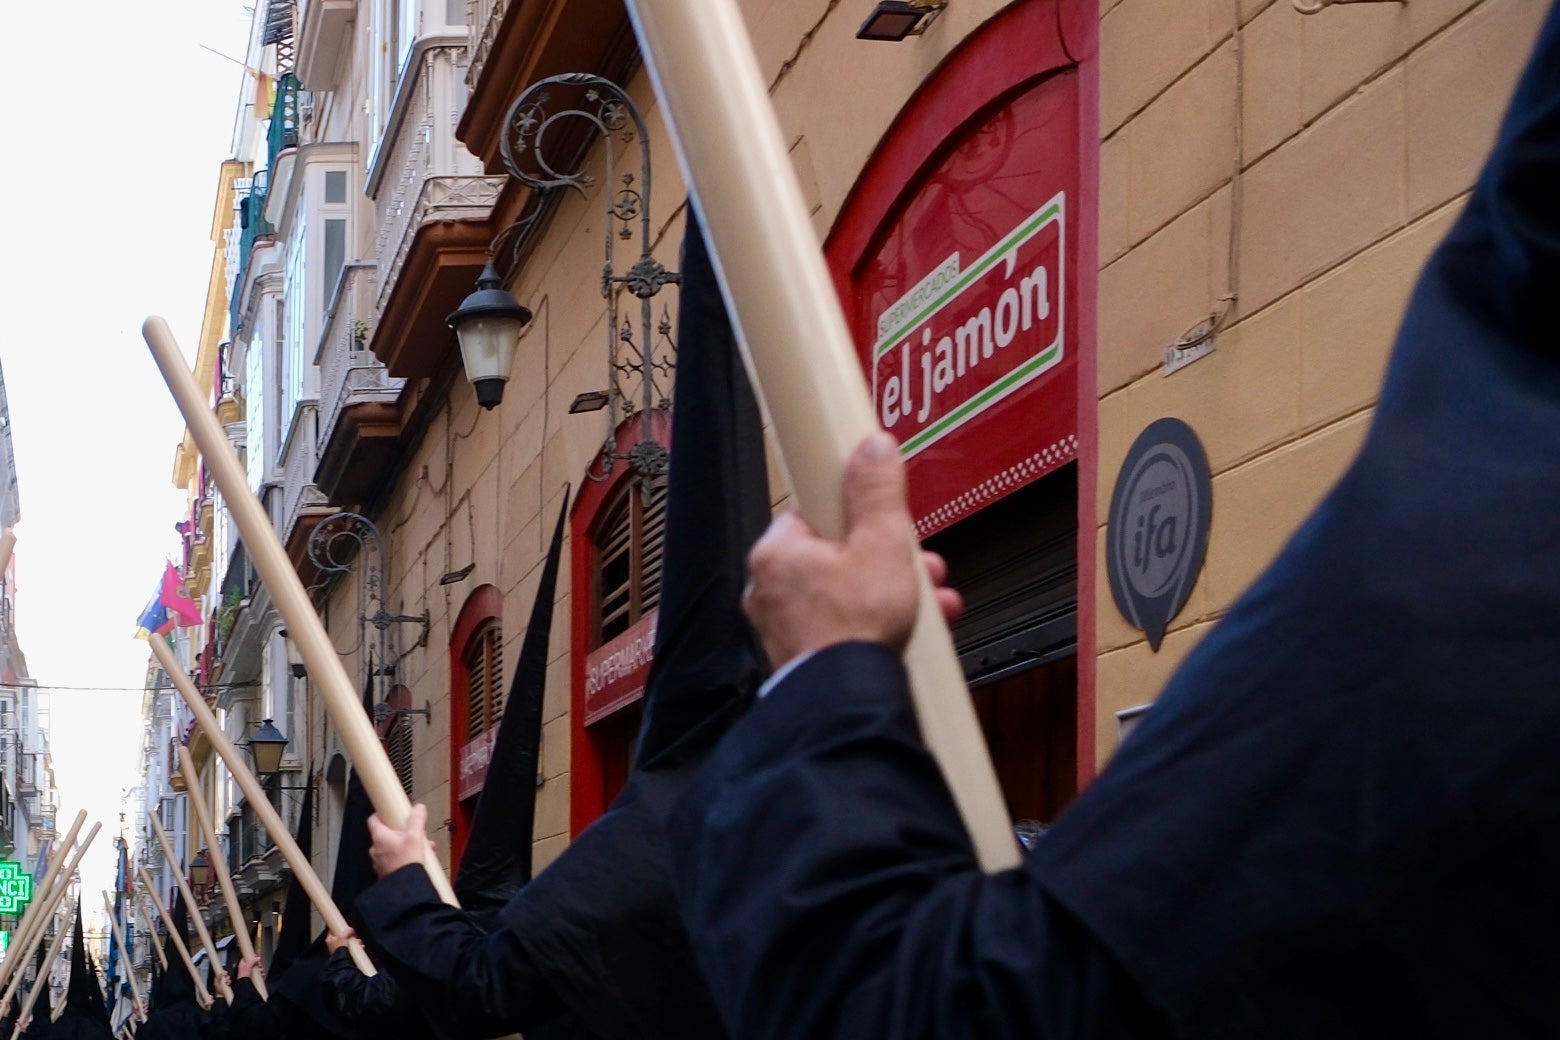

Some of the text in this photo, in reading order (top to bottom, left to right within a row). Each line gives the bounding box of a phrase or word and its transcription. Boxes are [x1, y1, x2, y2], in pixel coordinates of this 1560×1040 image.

[882, 248, 1050, 428] el jamón
[1134, 504, 1177, 575] ifa
